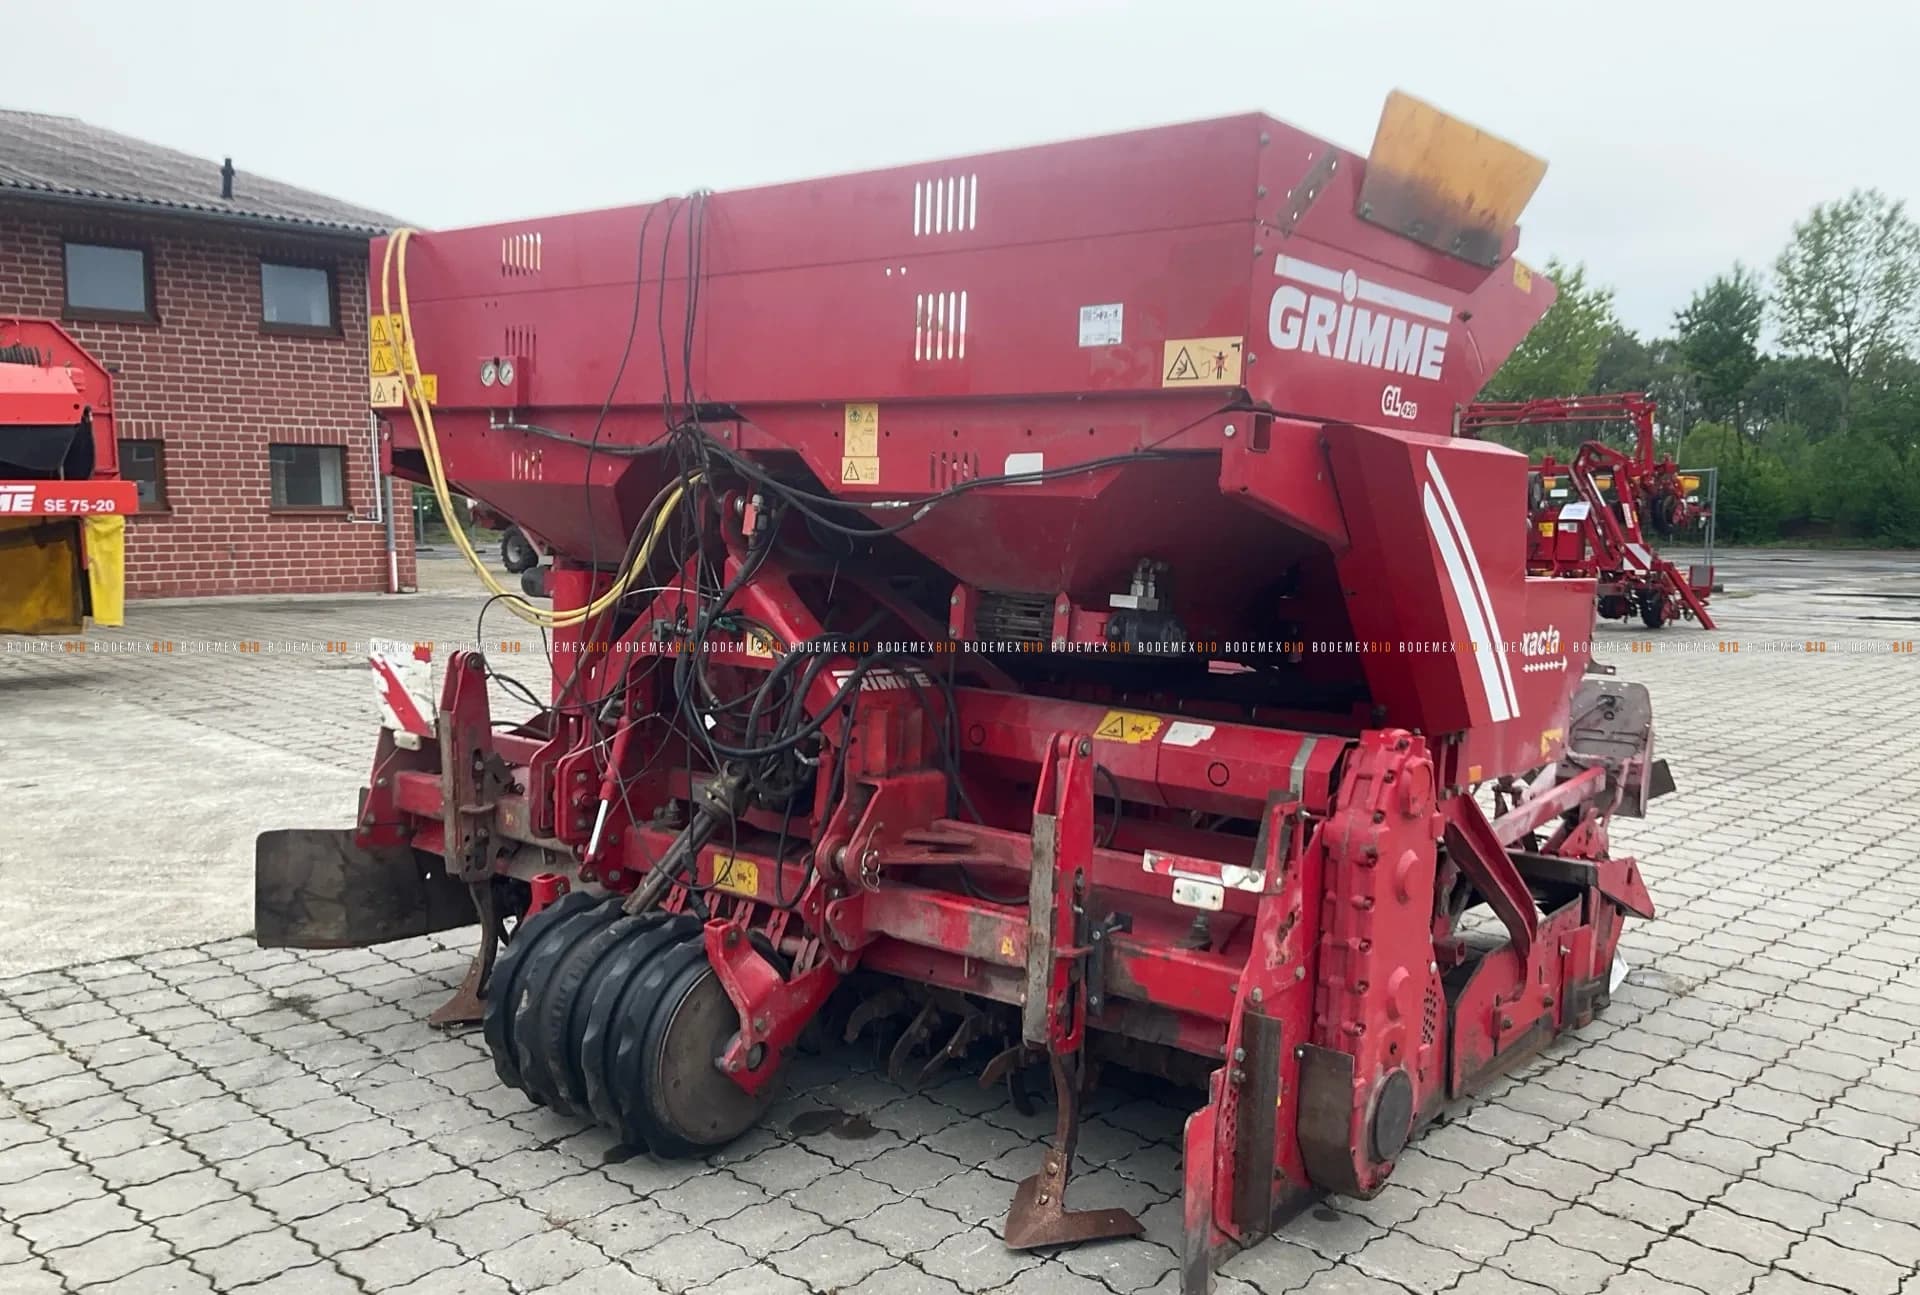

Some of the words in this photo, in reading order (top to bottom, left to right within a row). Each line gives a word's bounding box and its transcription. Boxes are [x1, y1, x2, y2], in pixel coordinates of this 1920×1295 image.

[1268, 270, 1449, 381] GRIMME
[1381, 384, 1402, 416] GL
[1400, 401, 1418, 420] 420
[44, 499, 67, 512] SE
[70, 499, 115, 512] 75-20
